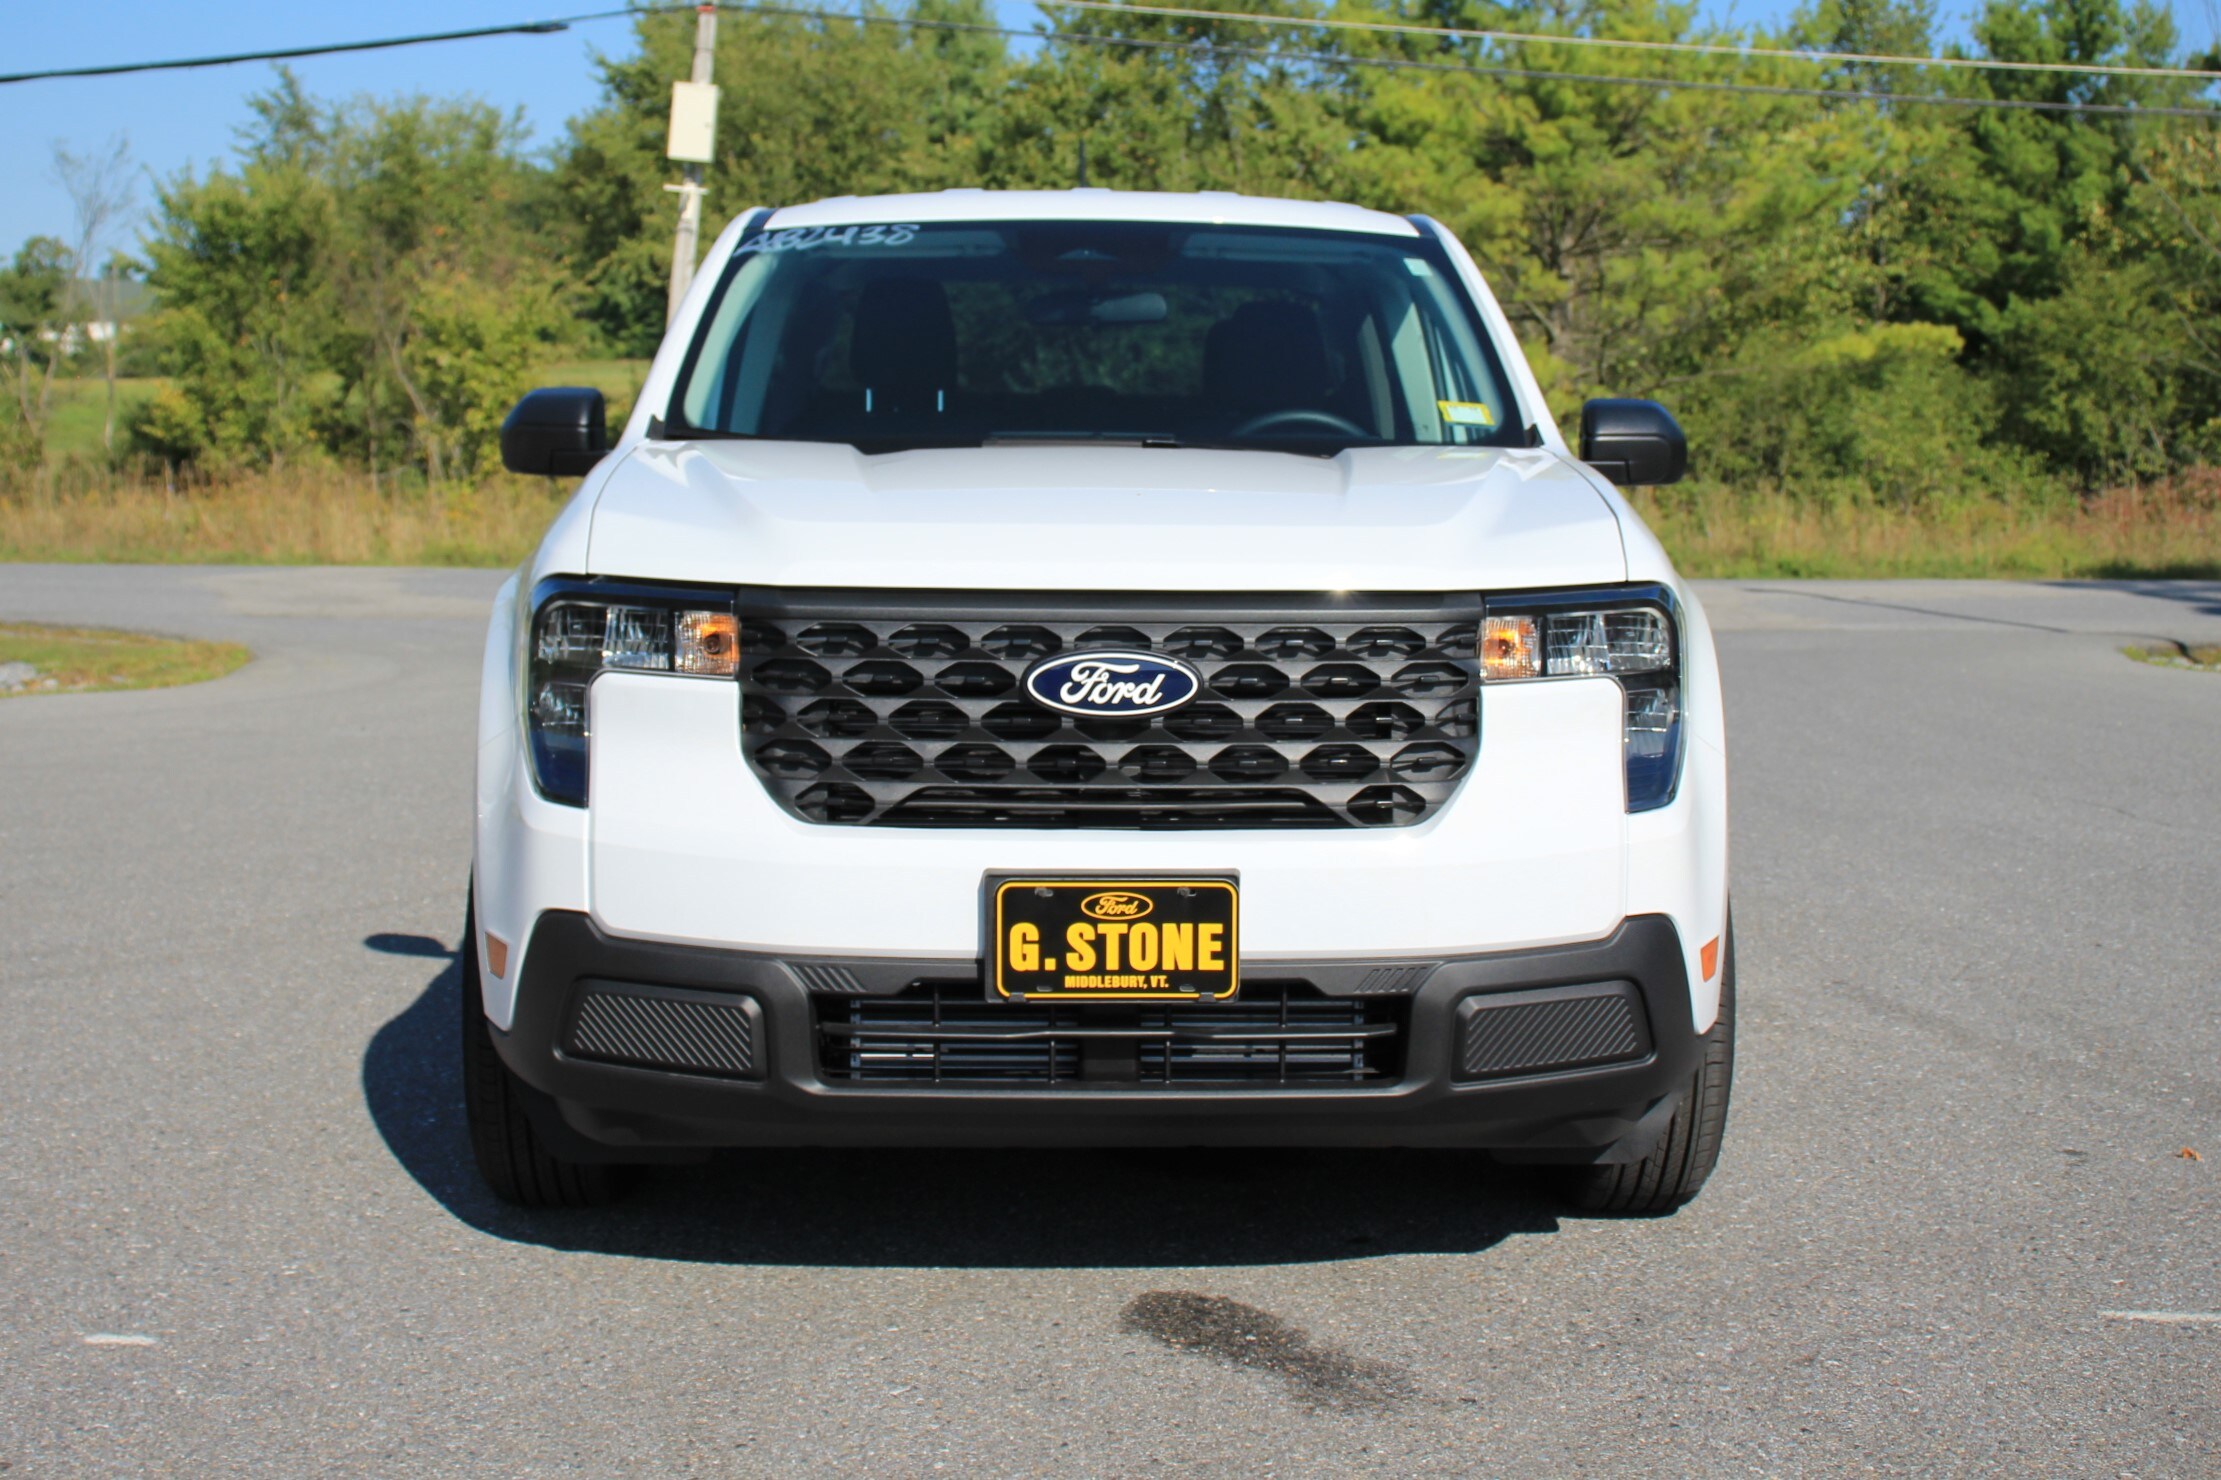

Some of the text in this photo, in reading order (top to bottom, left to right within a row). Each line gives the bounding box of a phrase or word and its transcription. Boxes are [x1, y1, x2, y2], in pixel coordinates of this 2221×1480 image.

[1060, 661, 1166, 705] Ford
[1095, 895, 1138, 916] Ford
[1009, 922, 1225, 972] G. STONE
[1064, 975, 1169, 989] MIDDLEBURY, VT.
